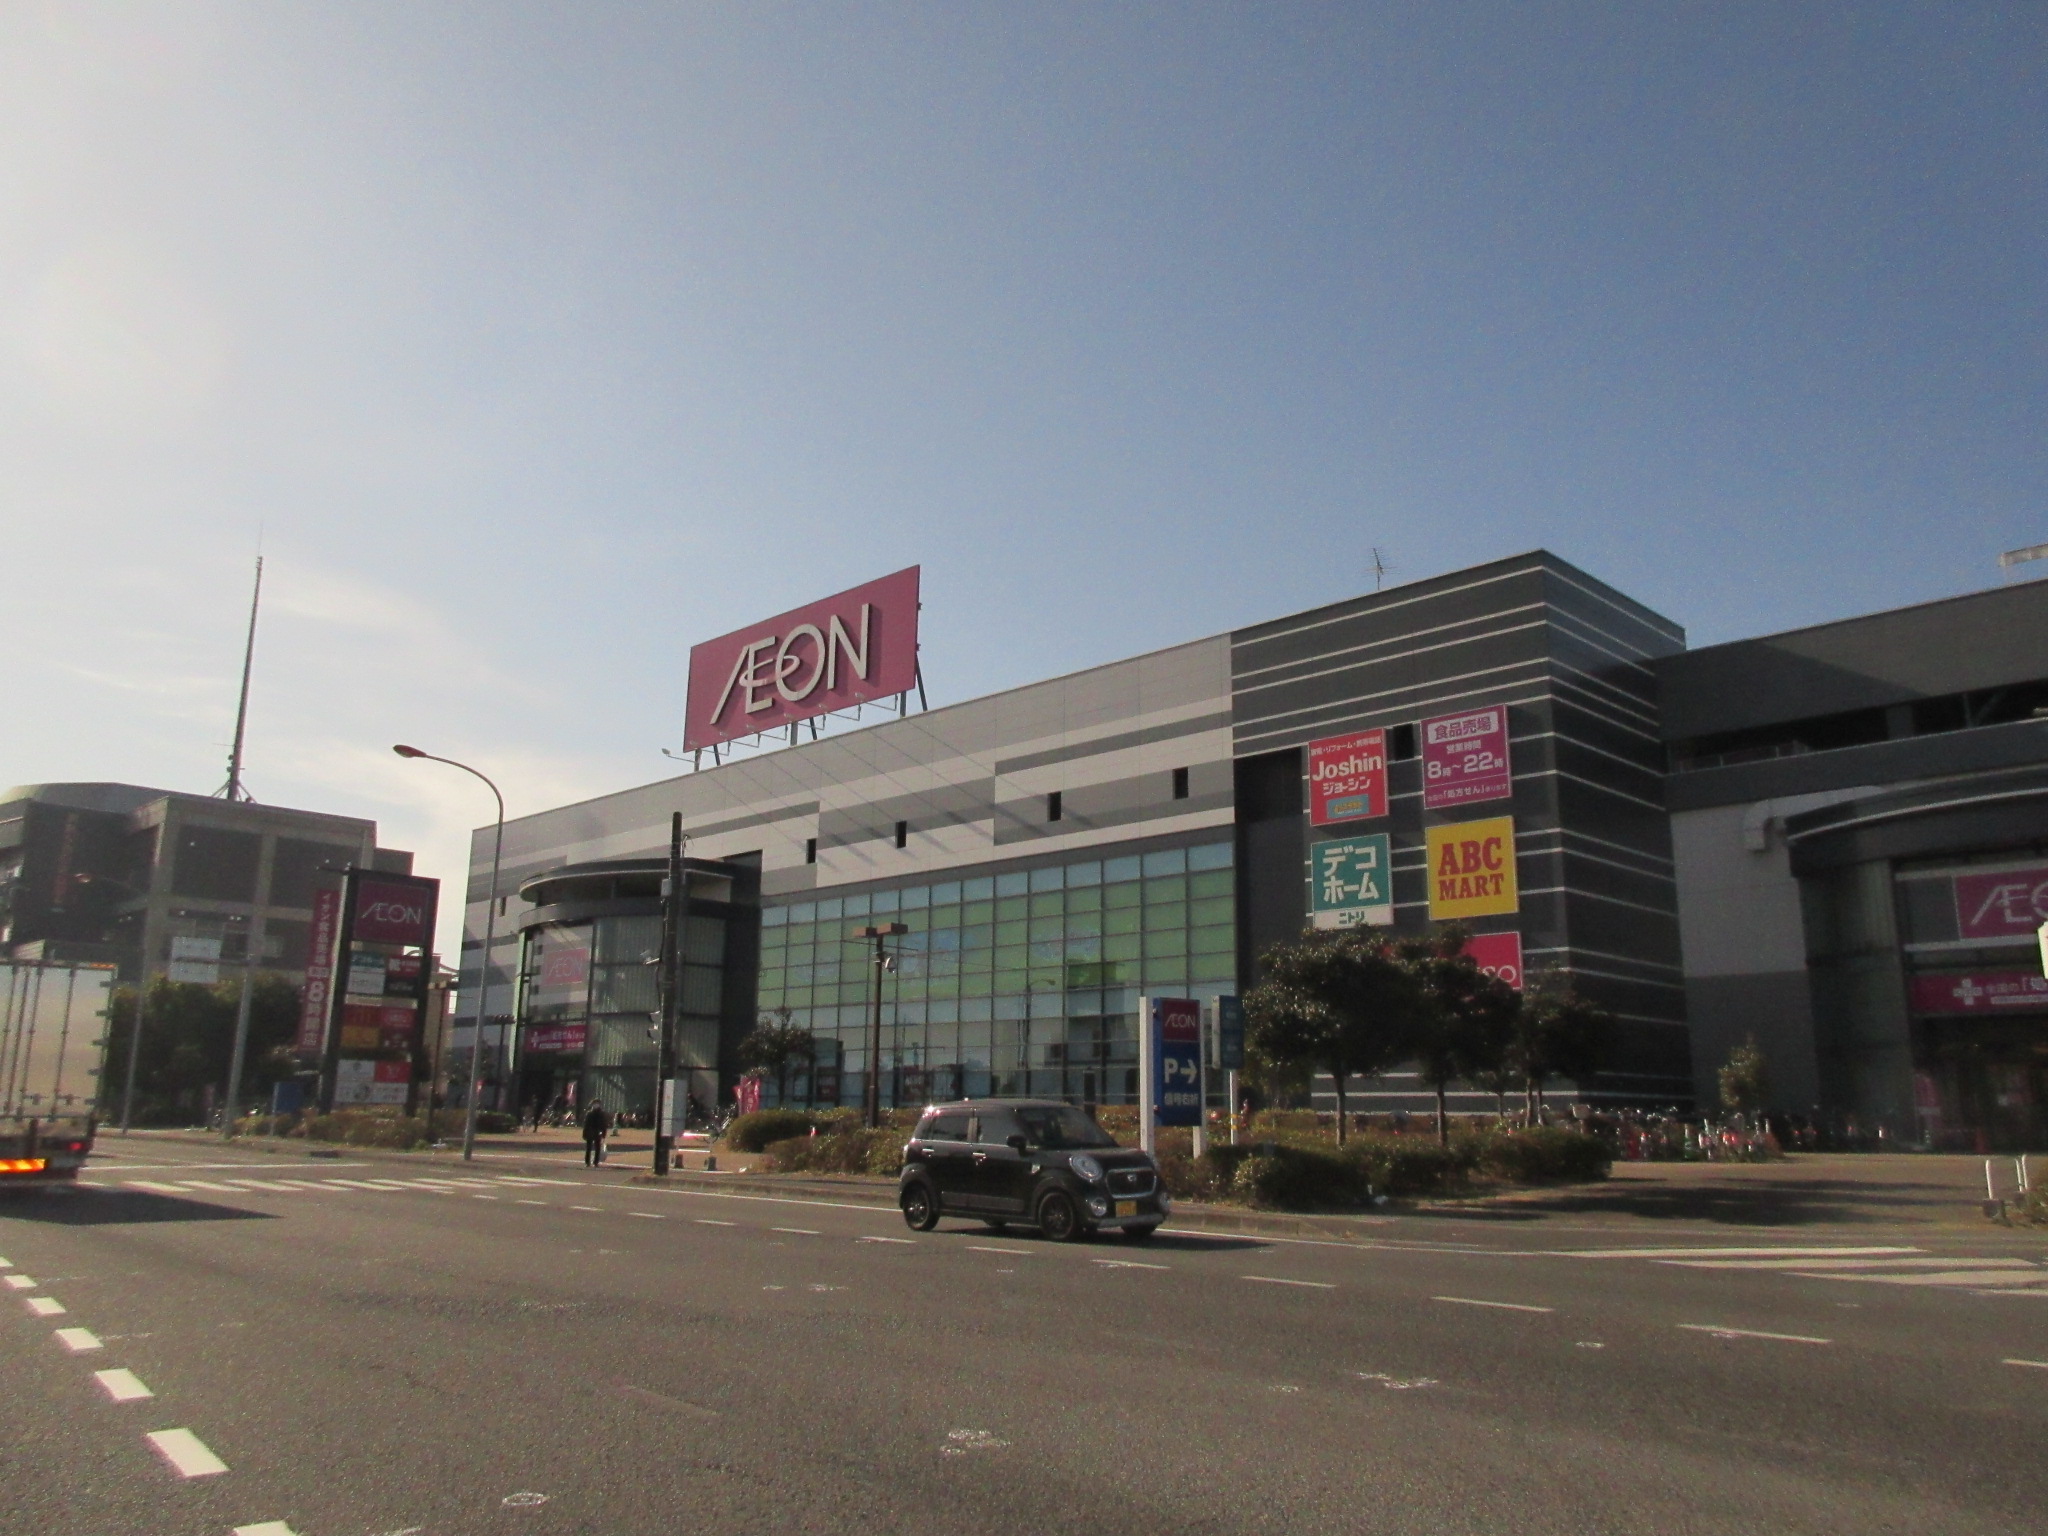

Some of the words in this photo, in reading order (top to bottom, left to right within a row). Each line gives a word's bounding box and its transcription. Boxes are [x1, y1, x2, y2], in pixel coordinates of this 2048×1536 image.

[1434, 716, 1491, 740] 食品売場
[1312, 752, 1382, 781] Joshin
[1323, 776, 1371, 796] ジョーシン
[1323, 845, 1377, 877] デコ
[1438, 837, 1503, 876] ABC
[1323, 872, 1379, 904] ホーム
[1438, 873, 1504, 901] MART
[1339, 911, 1364, 925] ニトリ
[1164, 1058, 1179, 1084] P
